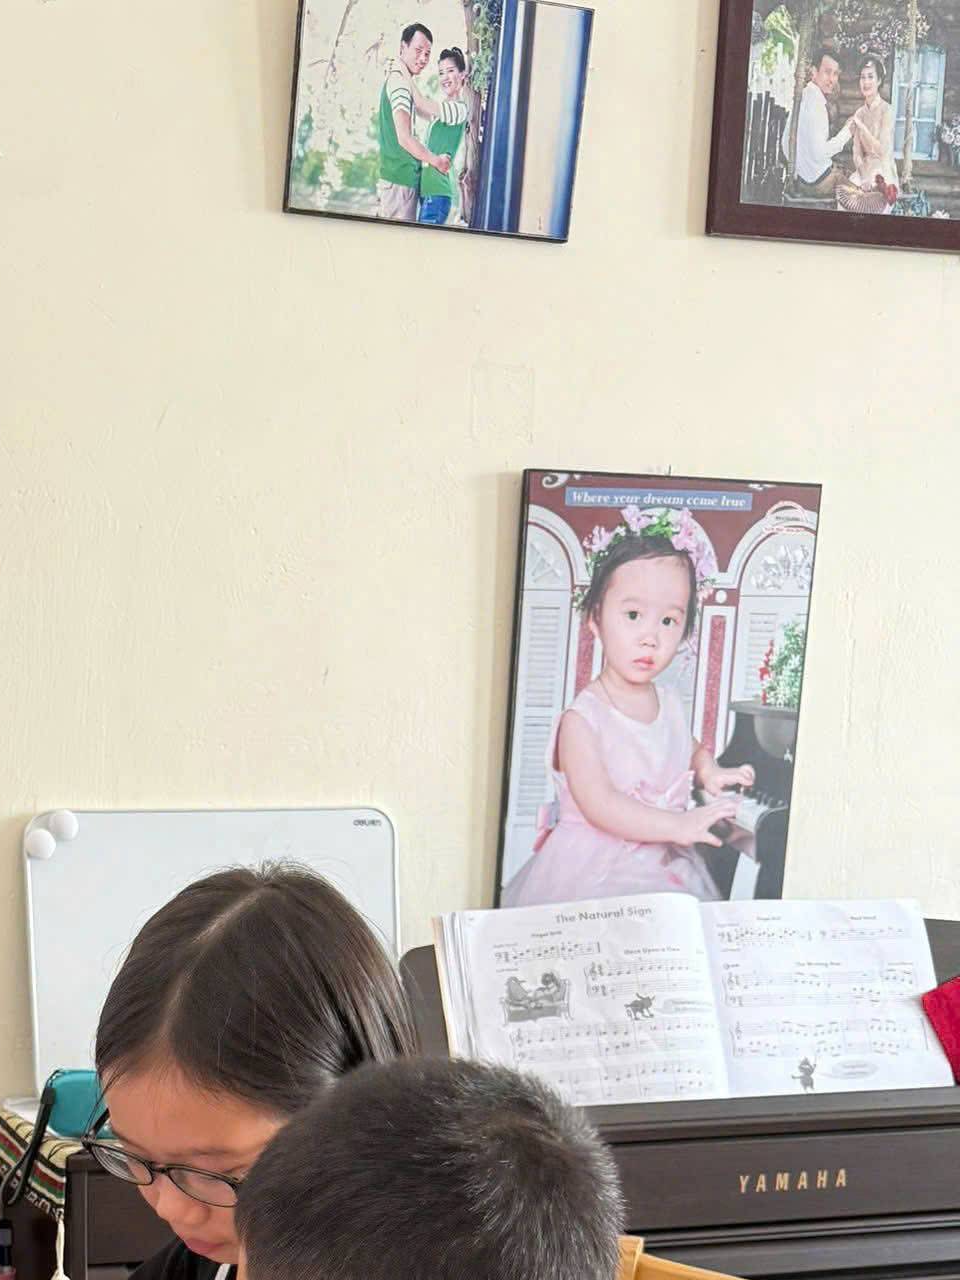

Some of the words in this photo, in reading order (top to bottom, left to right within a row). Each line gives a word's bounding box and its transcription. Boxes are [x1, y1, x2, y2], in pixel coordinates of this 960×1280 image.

[573, 492, 610, 503] Where
[612, 494, 640, 506] your
[643, 494, 683, 505] dream
[686, 496, 718, 506] come
[721, 496, 746, 508] true
[555, 914, 575, 923] The
[578, 909, 624, 922] Natural
[628, 906, 652, 916] Sign
[739, 1168, 847, 1194] YAMAHA
